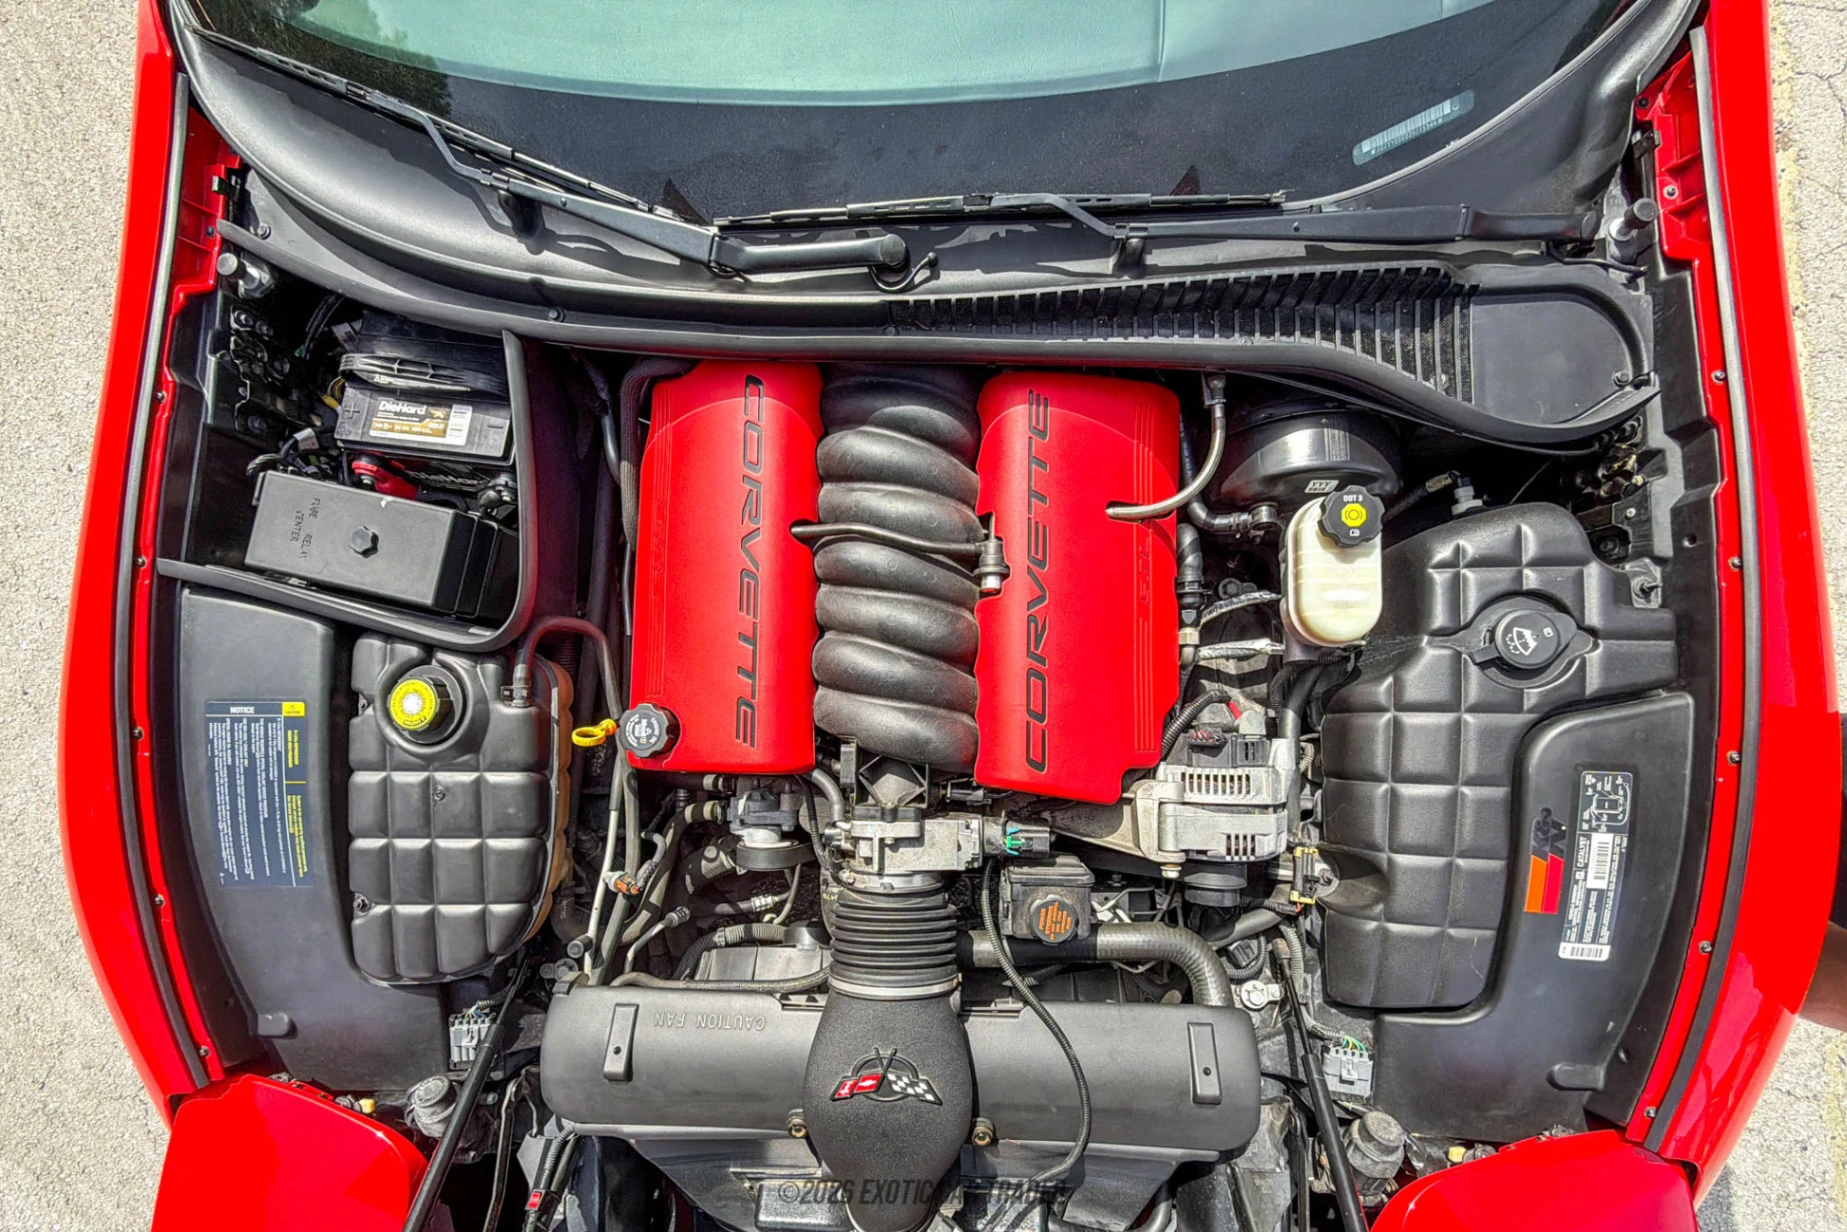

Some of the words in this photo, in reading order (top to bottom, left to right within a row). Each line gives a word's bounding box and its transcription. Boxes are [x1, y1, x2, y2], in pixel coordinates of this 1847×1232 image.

[378, 400, 427, 415] DieHard
[308, 497, 321, 519] FUSE
[1343, 494, 1357, 502] DOT
[1358, 494, 1363, 502] 3
[289, 510, 305, 543] CENTER
[735, 373, 765, 749] CORVETTE
[1025, 389, 1049, 774] CORVETTE
[229, 706, 255, 714] NOTICE
[1576, 836, 1585, 868] CATALYST
[1038, 908, 1046, 930] POWER
[653, 1012, 687, 1028] FAN
[695, 1014, 766, 1031] CAUTION
